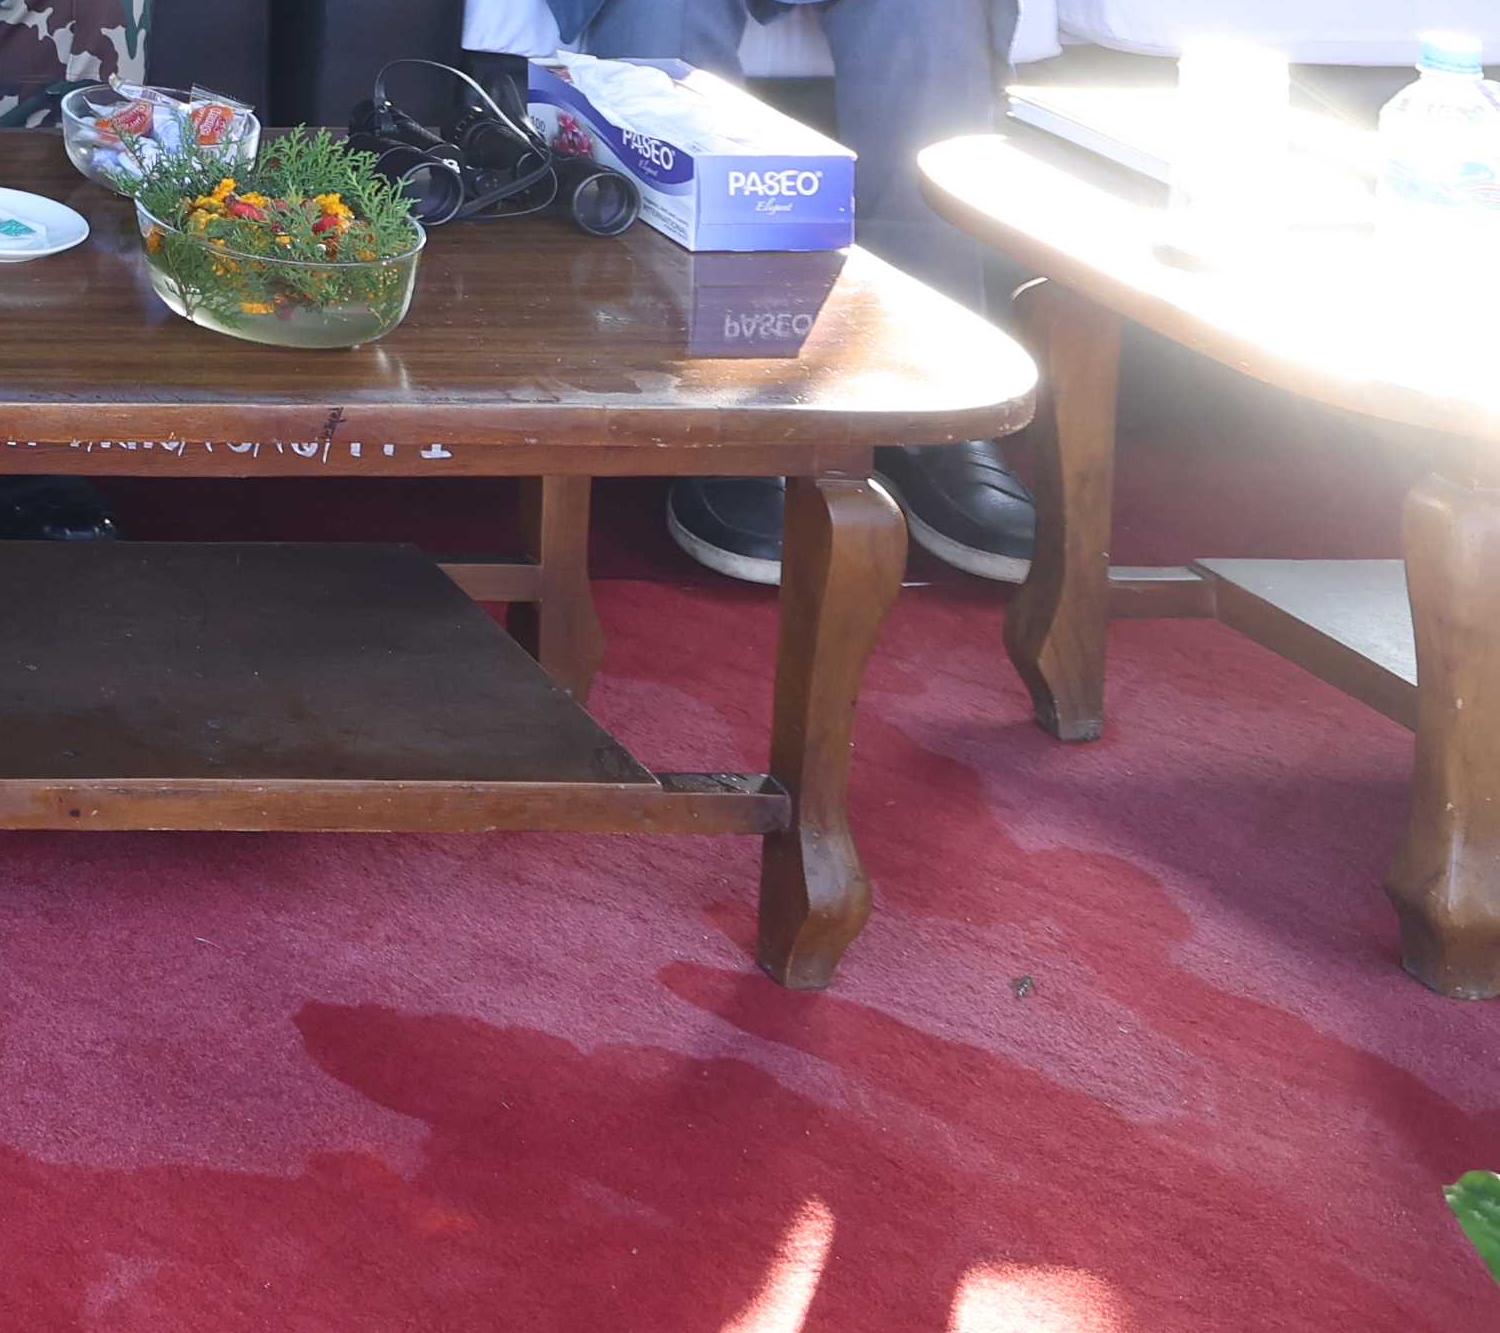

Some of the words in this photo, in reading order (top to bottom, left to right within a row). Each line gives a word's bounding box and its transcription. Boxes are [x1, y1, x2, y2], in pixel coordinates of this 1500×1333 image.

[622, 128, 674, 171] PASEO
[728, 169, 819, 196] PASEO
[755, 197, 794, 215] Elegant
